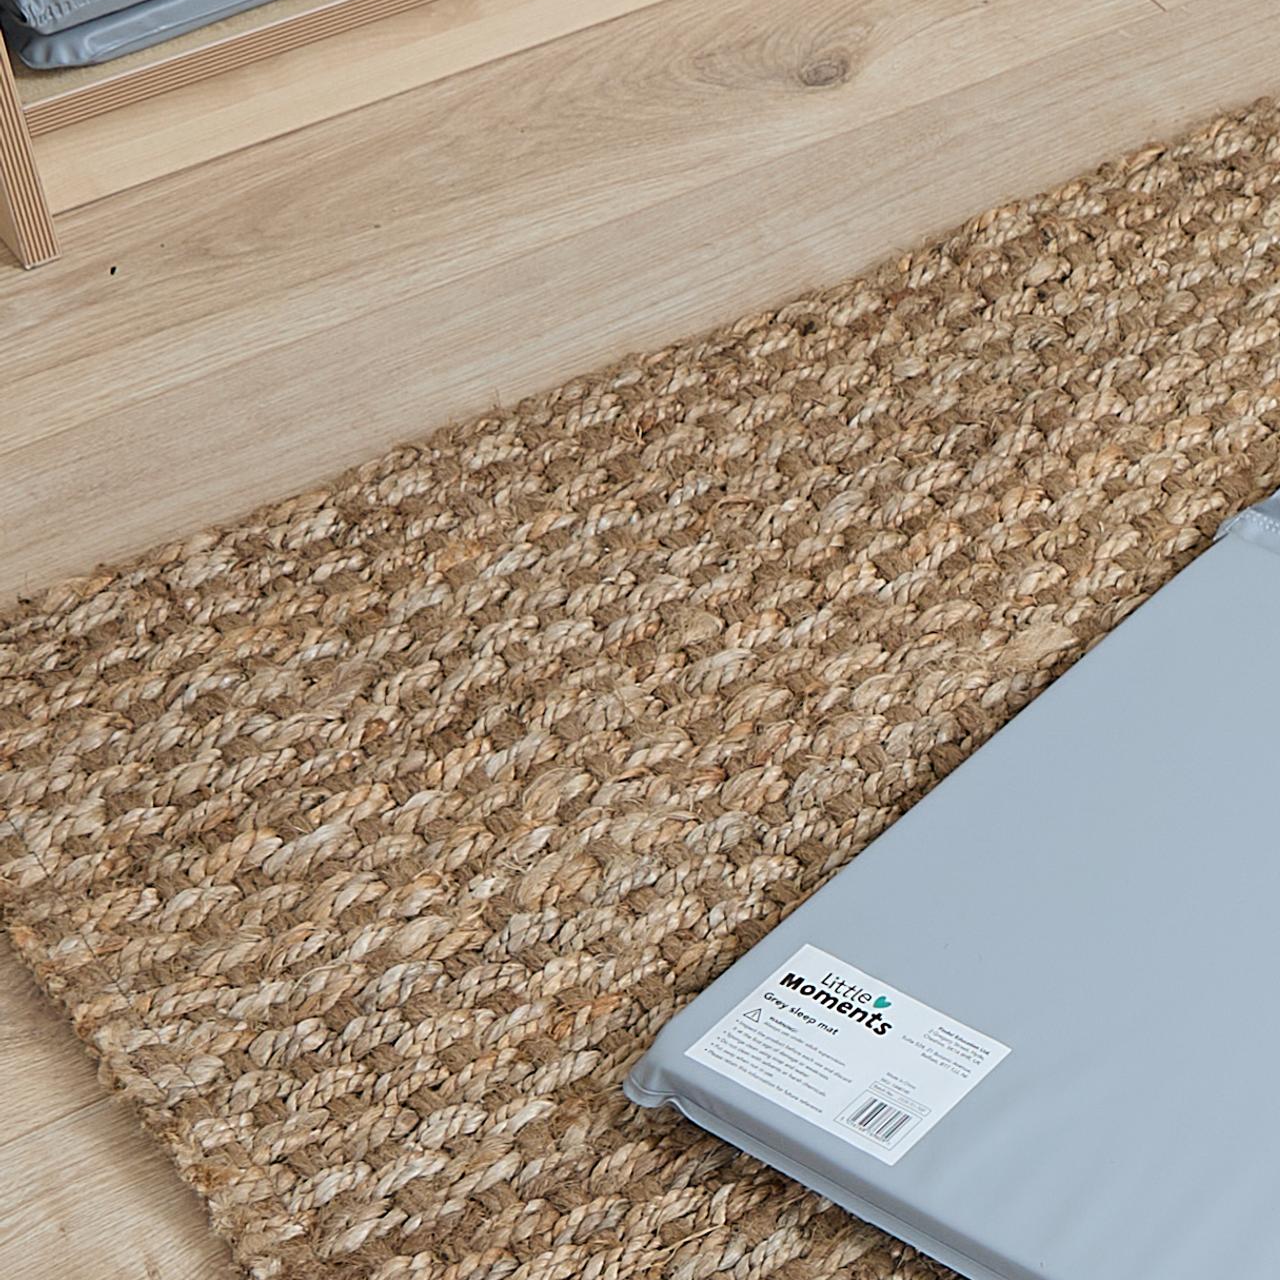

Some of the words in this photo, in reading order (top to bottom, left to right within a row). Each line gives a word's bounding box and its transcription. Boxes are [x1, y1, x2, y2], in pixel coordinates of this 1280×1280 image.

[779, 972, 893, 1036] Moments
[821, 972, 872, 1004] Little
[763, 991, 789, 1010] Grey
[789, 1007, 817, 1025] sleep
[817, 1022, 839, 1036] mat
